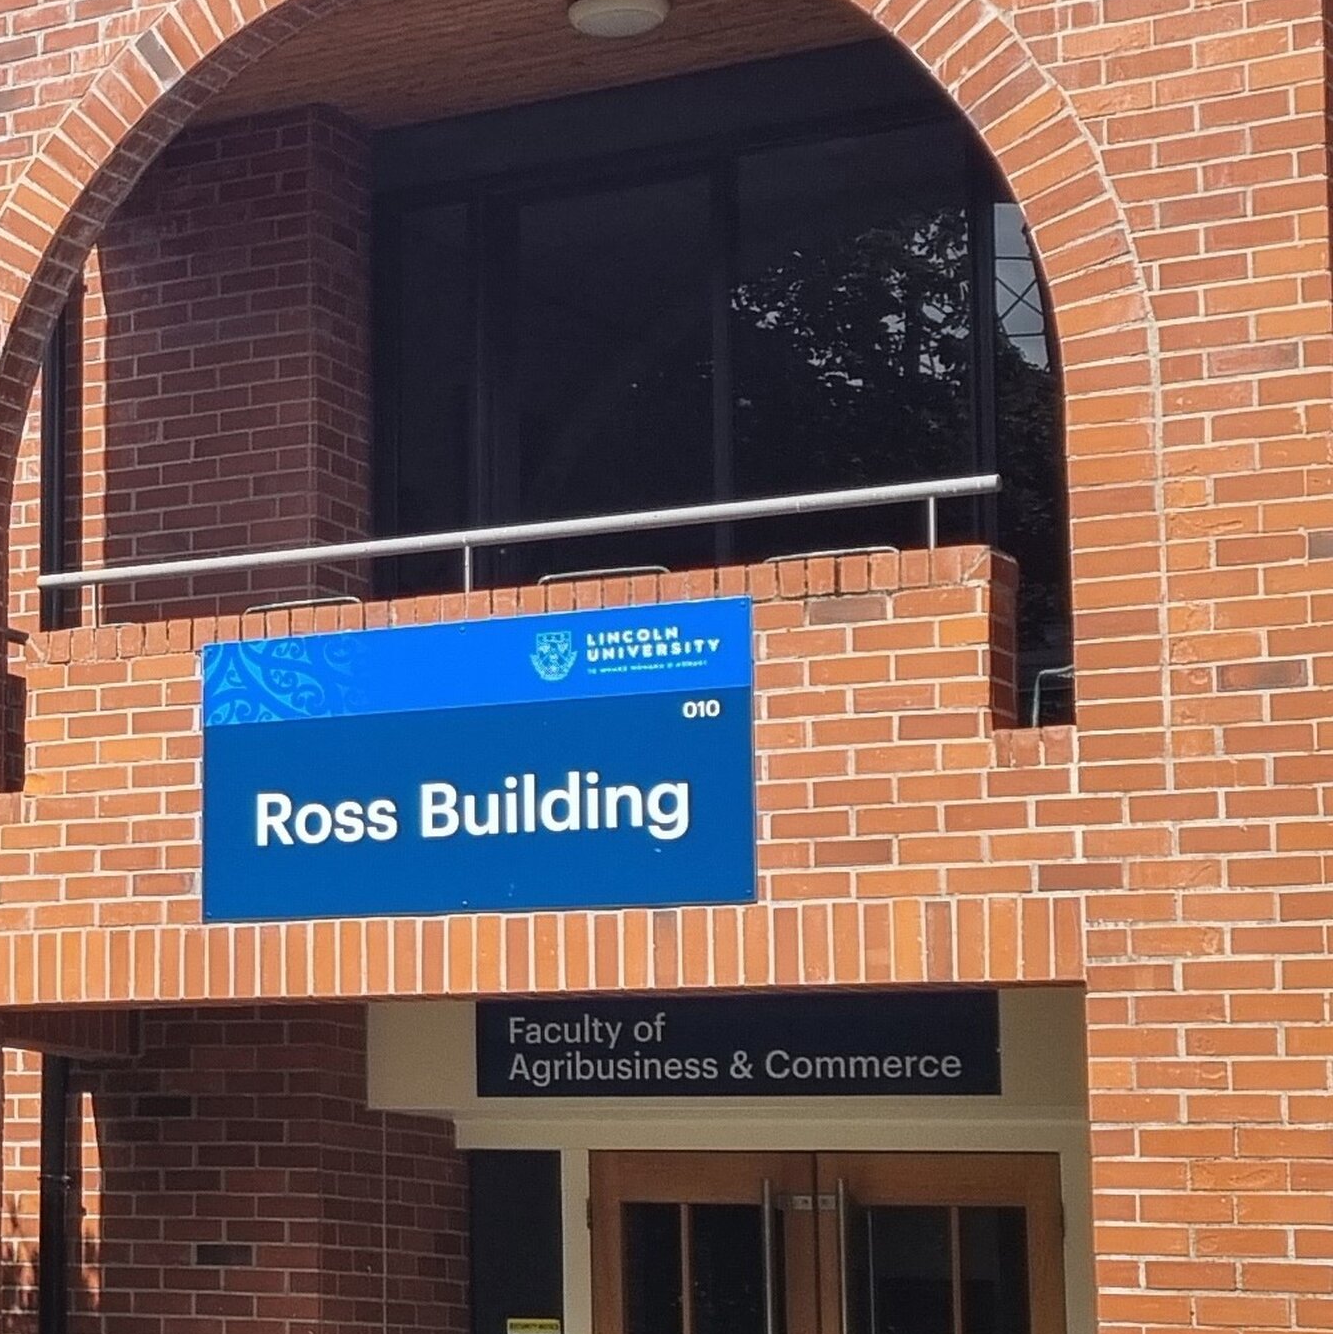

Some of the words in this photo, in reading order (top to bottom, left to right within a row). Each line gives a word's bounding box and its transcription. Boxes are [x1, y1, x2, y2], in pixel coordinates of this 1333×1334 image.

[586, 626, 679, 647] LINCOLN
[586, 638, 721, 662] UNIVERSITY
[682, 699, 721, 718] 010
[255, 792, 398, 847] Ross
[420, 770, 690, 841] Building
[507, 1013, 622, 1049] Faculty
[632, 1012, 666, 1043] of
[507, 1051, 719, 1087] Agribusiness
[728, 1050, 754, 1080] &
[764, 1050, 963, 1080] Commerce
